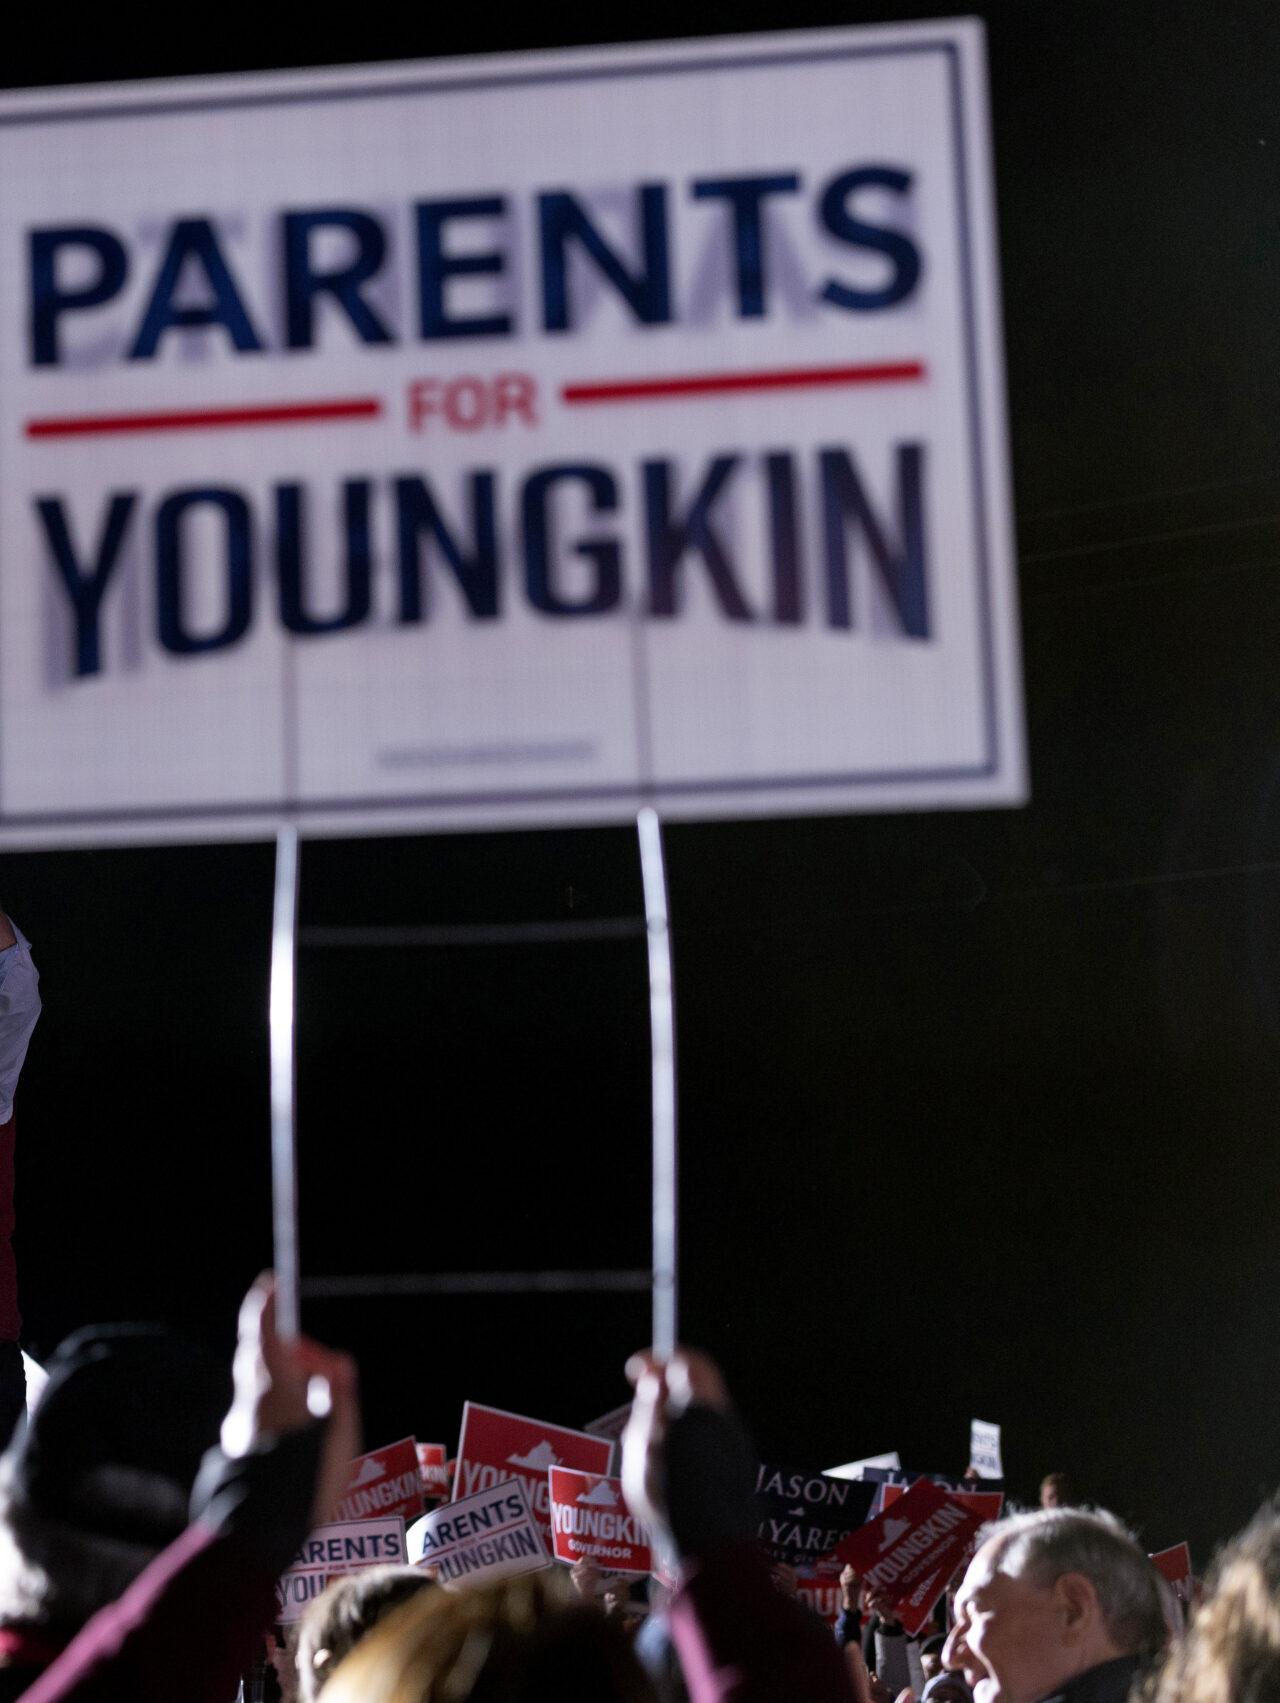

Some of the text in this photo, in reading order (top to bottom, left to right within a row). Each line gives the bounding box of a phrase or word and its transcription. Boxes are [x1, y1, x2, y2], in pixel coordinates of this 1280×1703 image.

[26, 163, 925, 367] PARENTS
[407, 373, 539, 434] FOR
[35, 439, 933, 680] YOUNGKIN
[755, 1464, 849, 1506] JASON
[296, 1533, 400, 1565] ARENTS
[422, 1495, 524, 1554] ARENTS
[568, 1539, 632, 1559] GOVERNOR
[862, 1502, 968, 1585] YOUNGKIN
